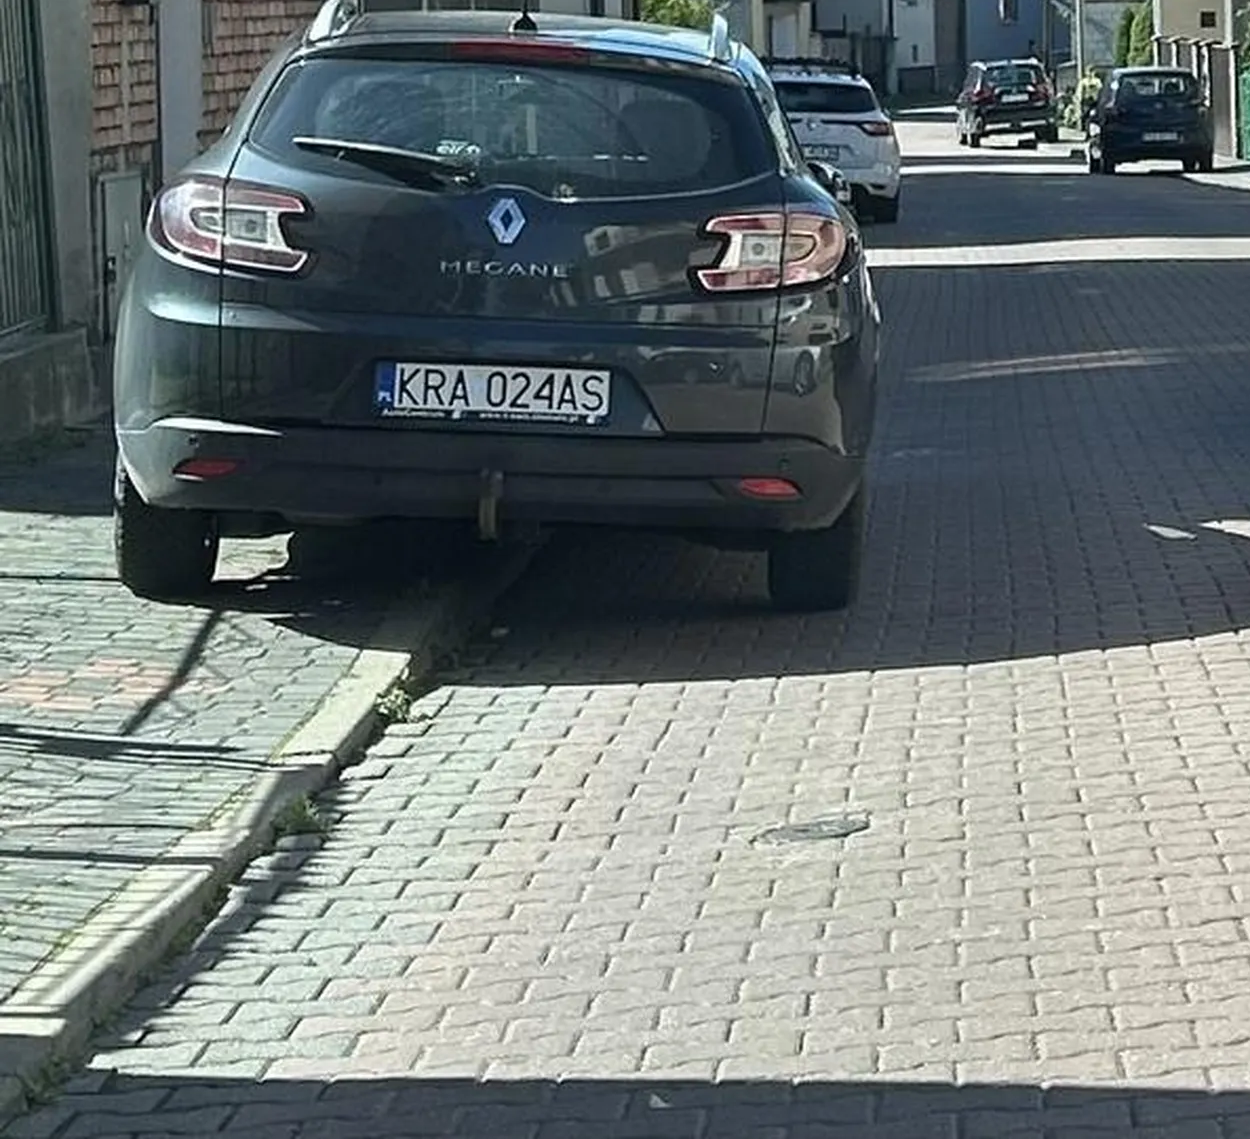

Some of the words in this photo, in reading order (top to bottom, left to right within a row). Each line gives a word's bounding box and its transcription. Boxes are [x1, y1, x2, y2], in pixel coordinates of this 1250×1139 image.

[439, 261, 570, 278] MEGANE
[398, 368, 471, 408] KRA
[486, 370, 604, 412] 024AS
